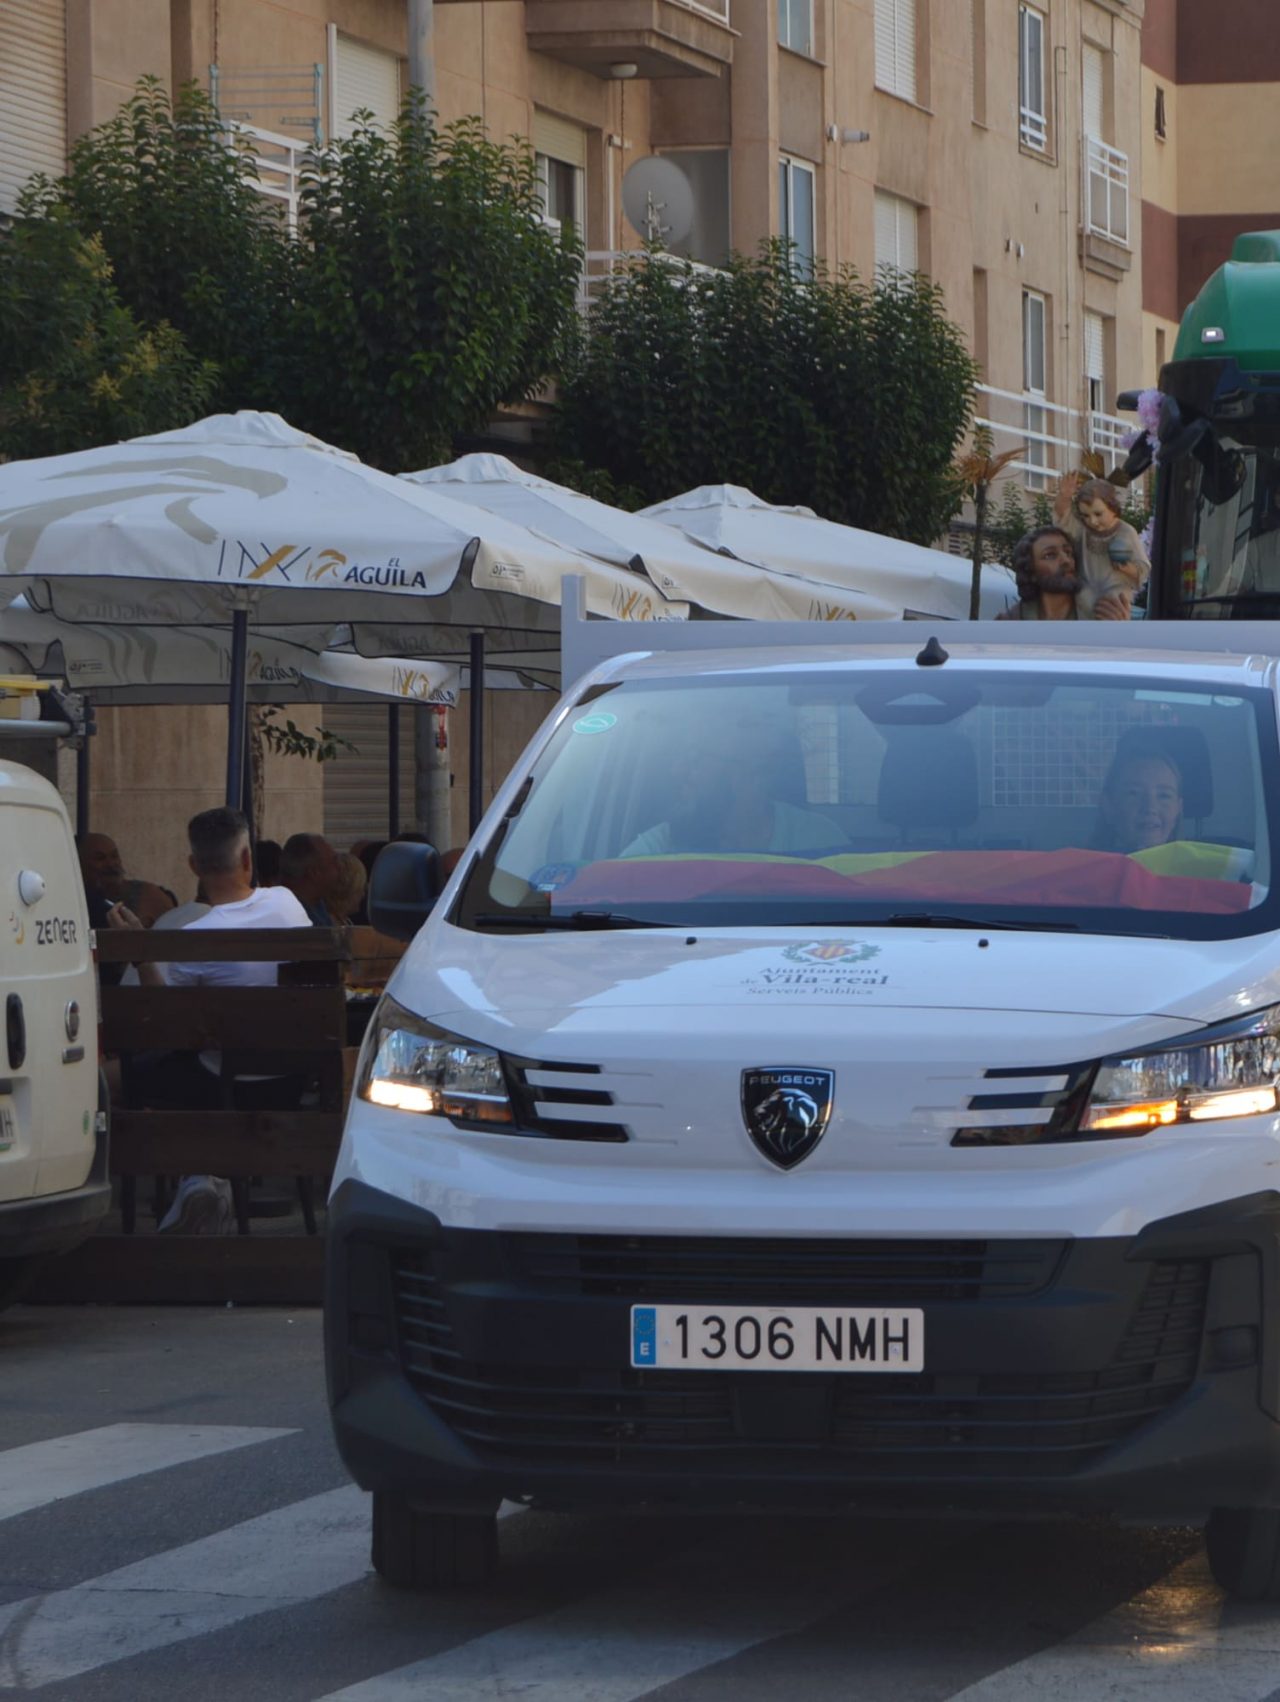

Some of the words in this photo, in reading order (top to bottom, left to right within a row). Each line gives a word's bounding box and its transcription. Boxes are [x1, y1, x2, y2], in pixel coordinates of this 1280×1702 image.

[388, 557, 399, 567] EL
[35, 917, 77, 944] ZENER
[760, 967, 880, 975] Ajuntament
[763, 974, 889, 985] Vila-real
[750, 1075, 825, 1085] PEUGEOT
[640, 1342, 649, 1355] E
[676, 1315, 794, 1360] 1306
[815, 1317, 909, 1361] NMH
